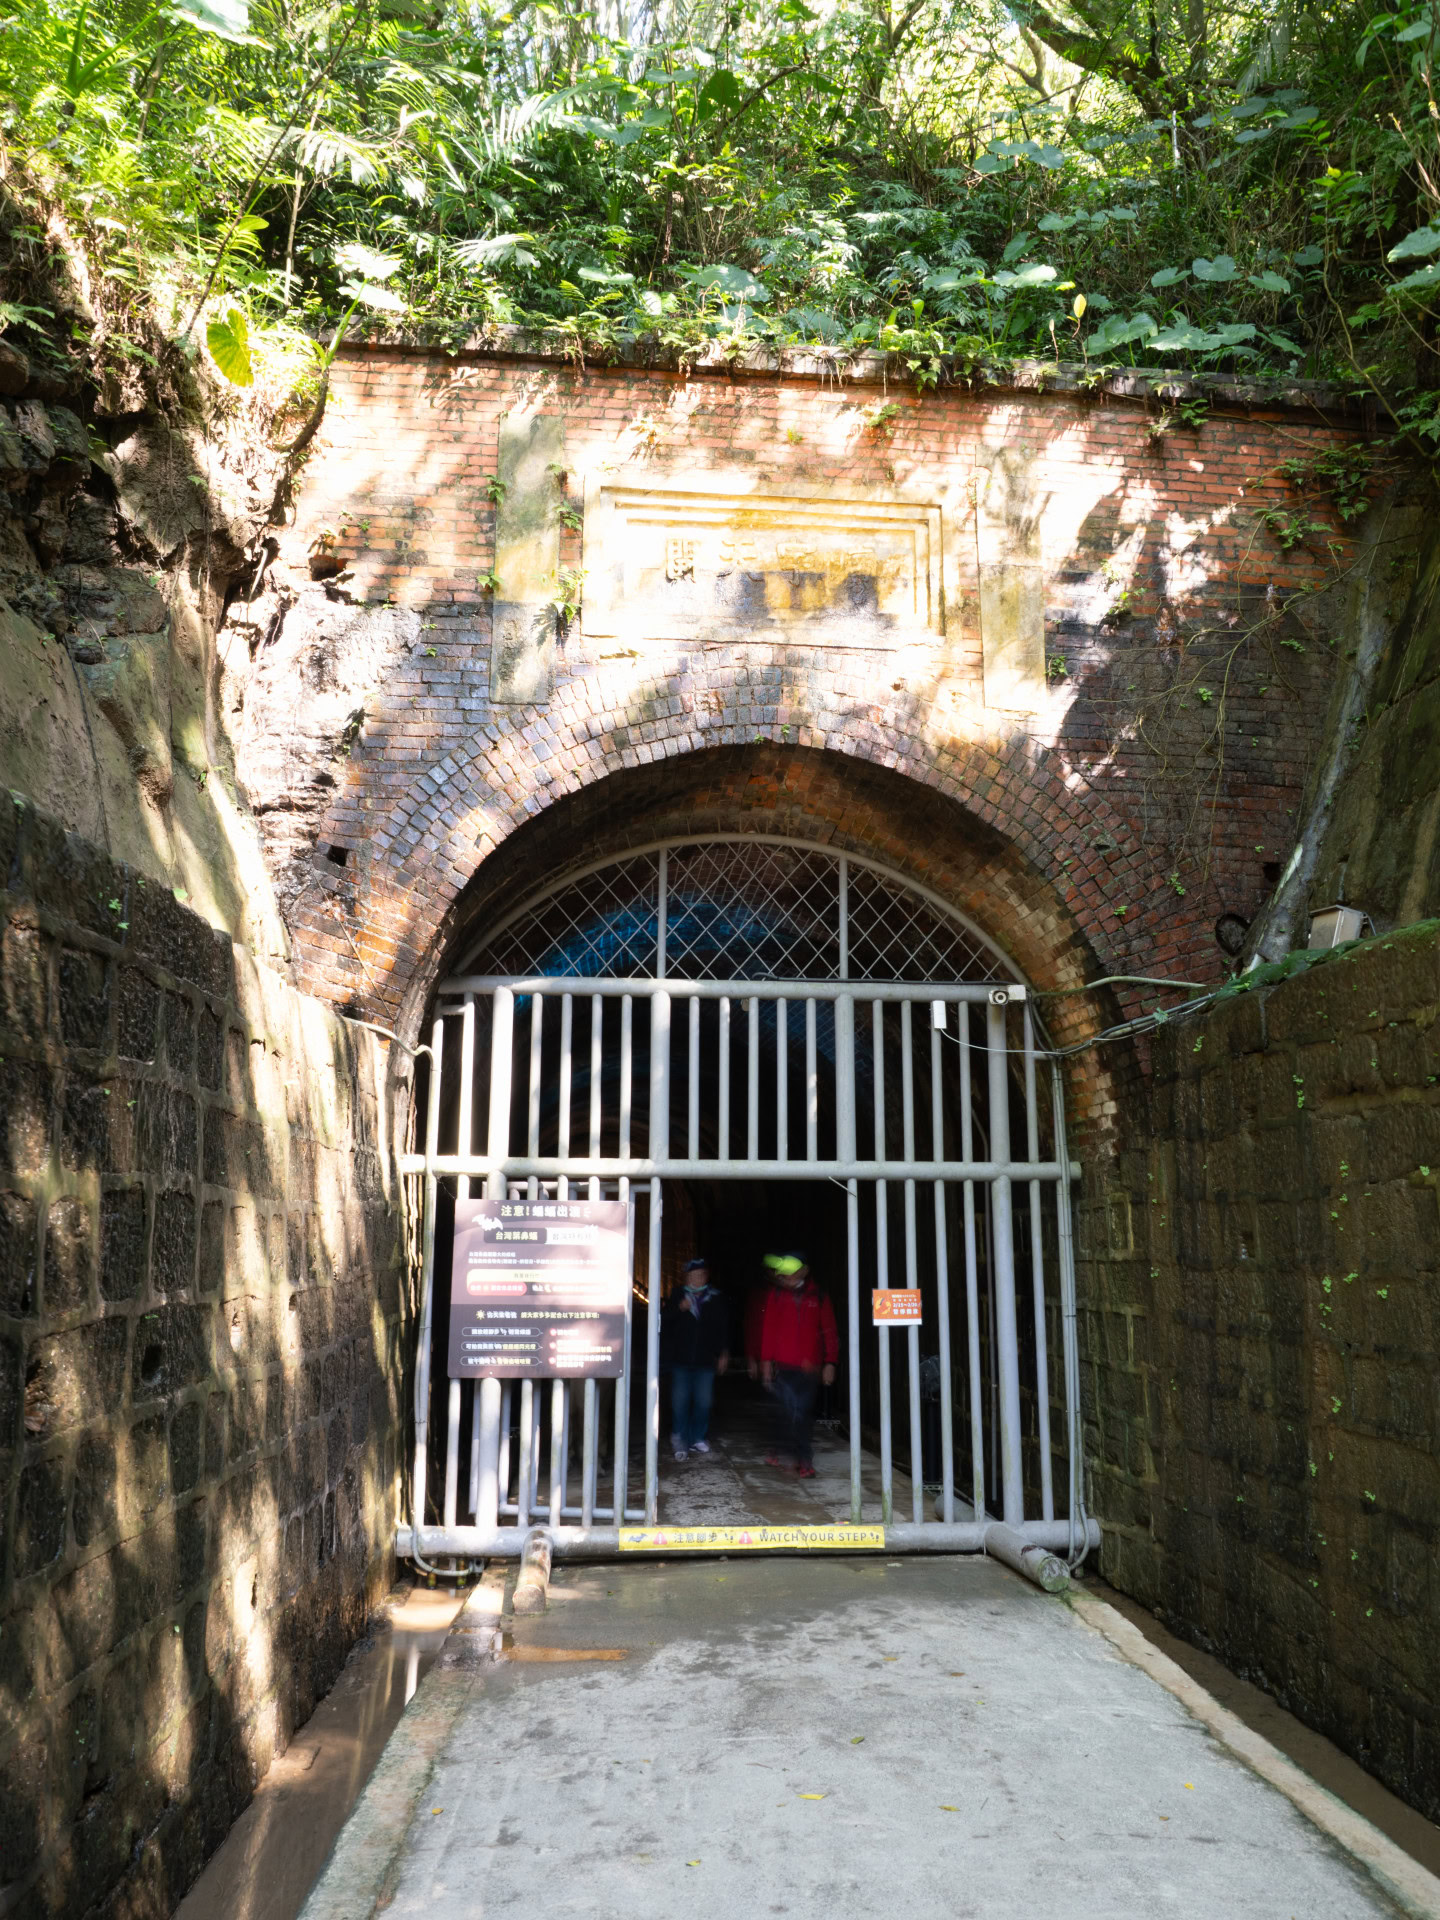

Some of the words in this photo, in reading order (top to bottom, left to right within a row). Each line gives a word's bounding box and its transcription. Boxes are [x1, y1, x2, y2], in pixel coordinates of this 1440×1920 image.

[759, 1532, 799, 1542] WATCH
[801, 1532, 835, 1542] YOUR
[838, 1531, 867, 1542] STEP
